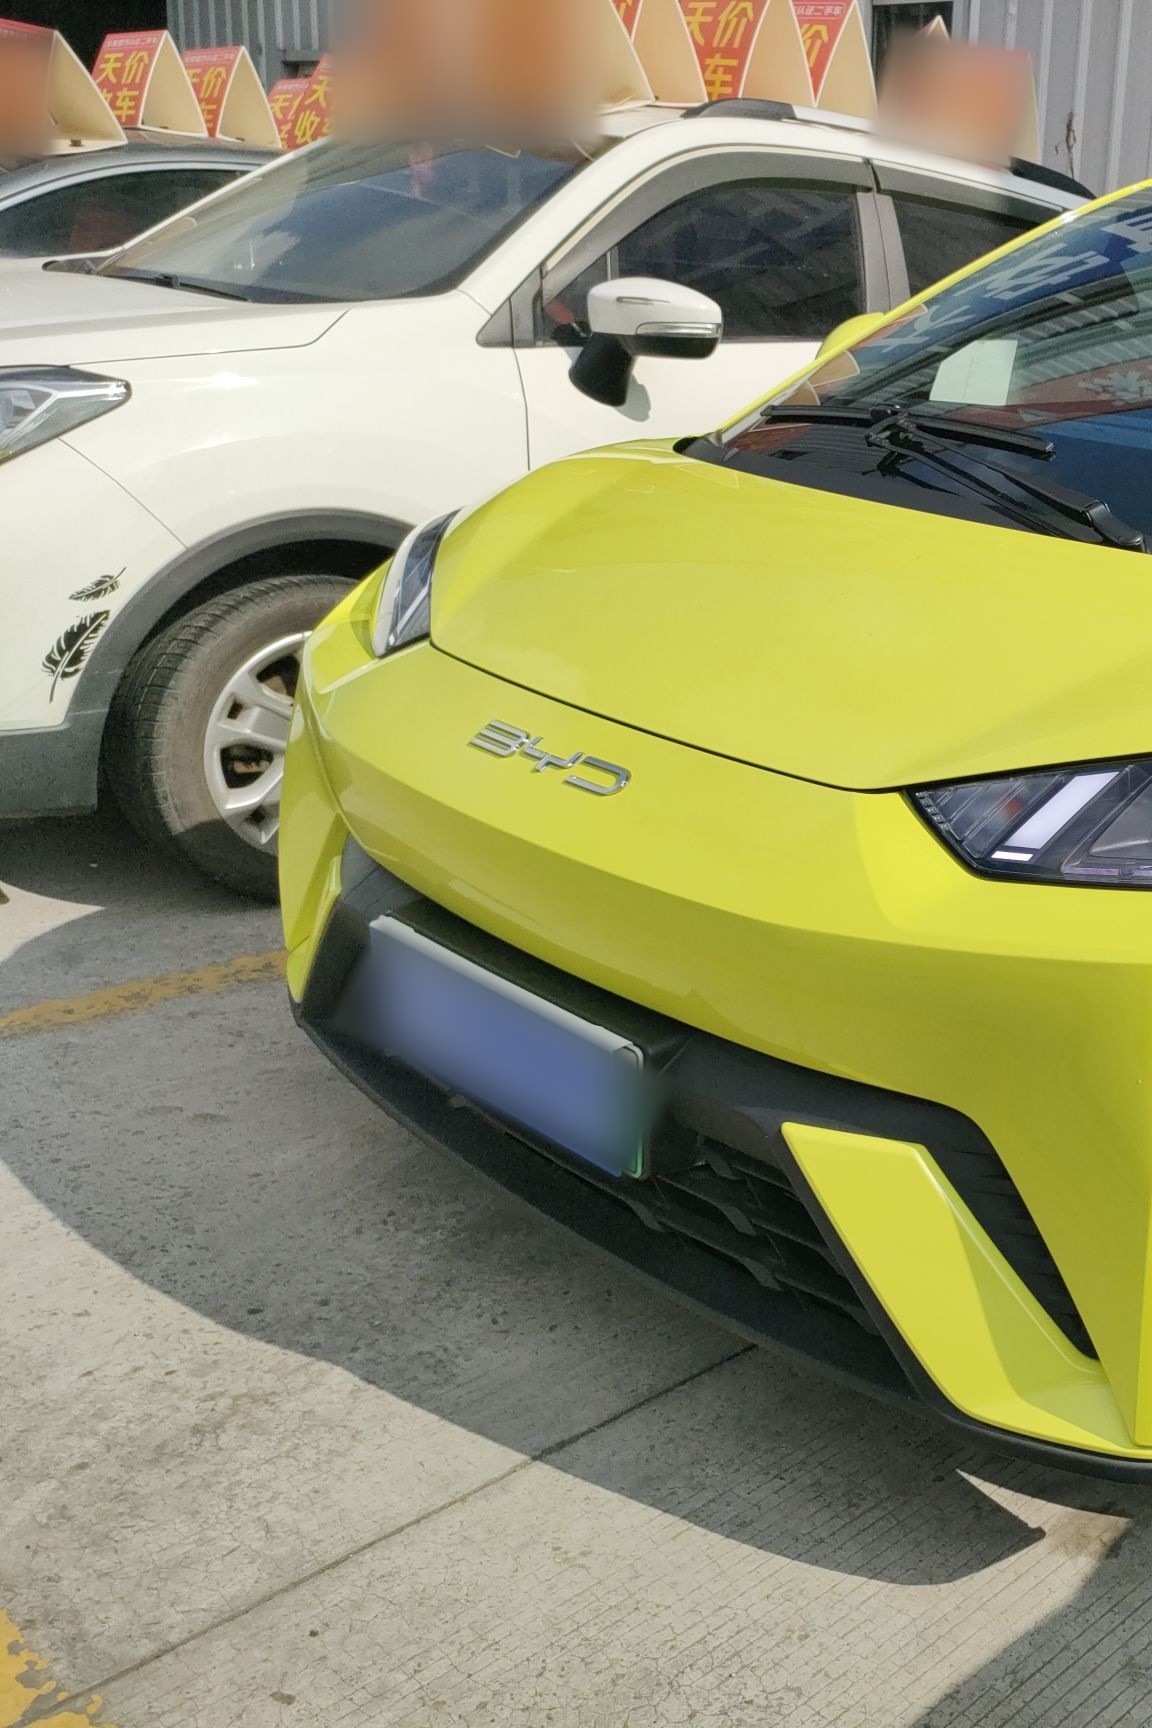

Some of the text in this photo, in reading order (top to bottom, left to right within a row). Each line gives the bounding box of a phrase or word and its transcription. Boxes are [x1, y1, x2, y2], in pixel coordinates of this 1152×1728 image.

[684, 0, 754, 48] 天价
[793, 5, 844, 17] 认证二手车
[96, 51, 149, 84] 天价
[271, 92, 304, 119] 天
[469, 719, 632, 796] BYD
